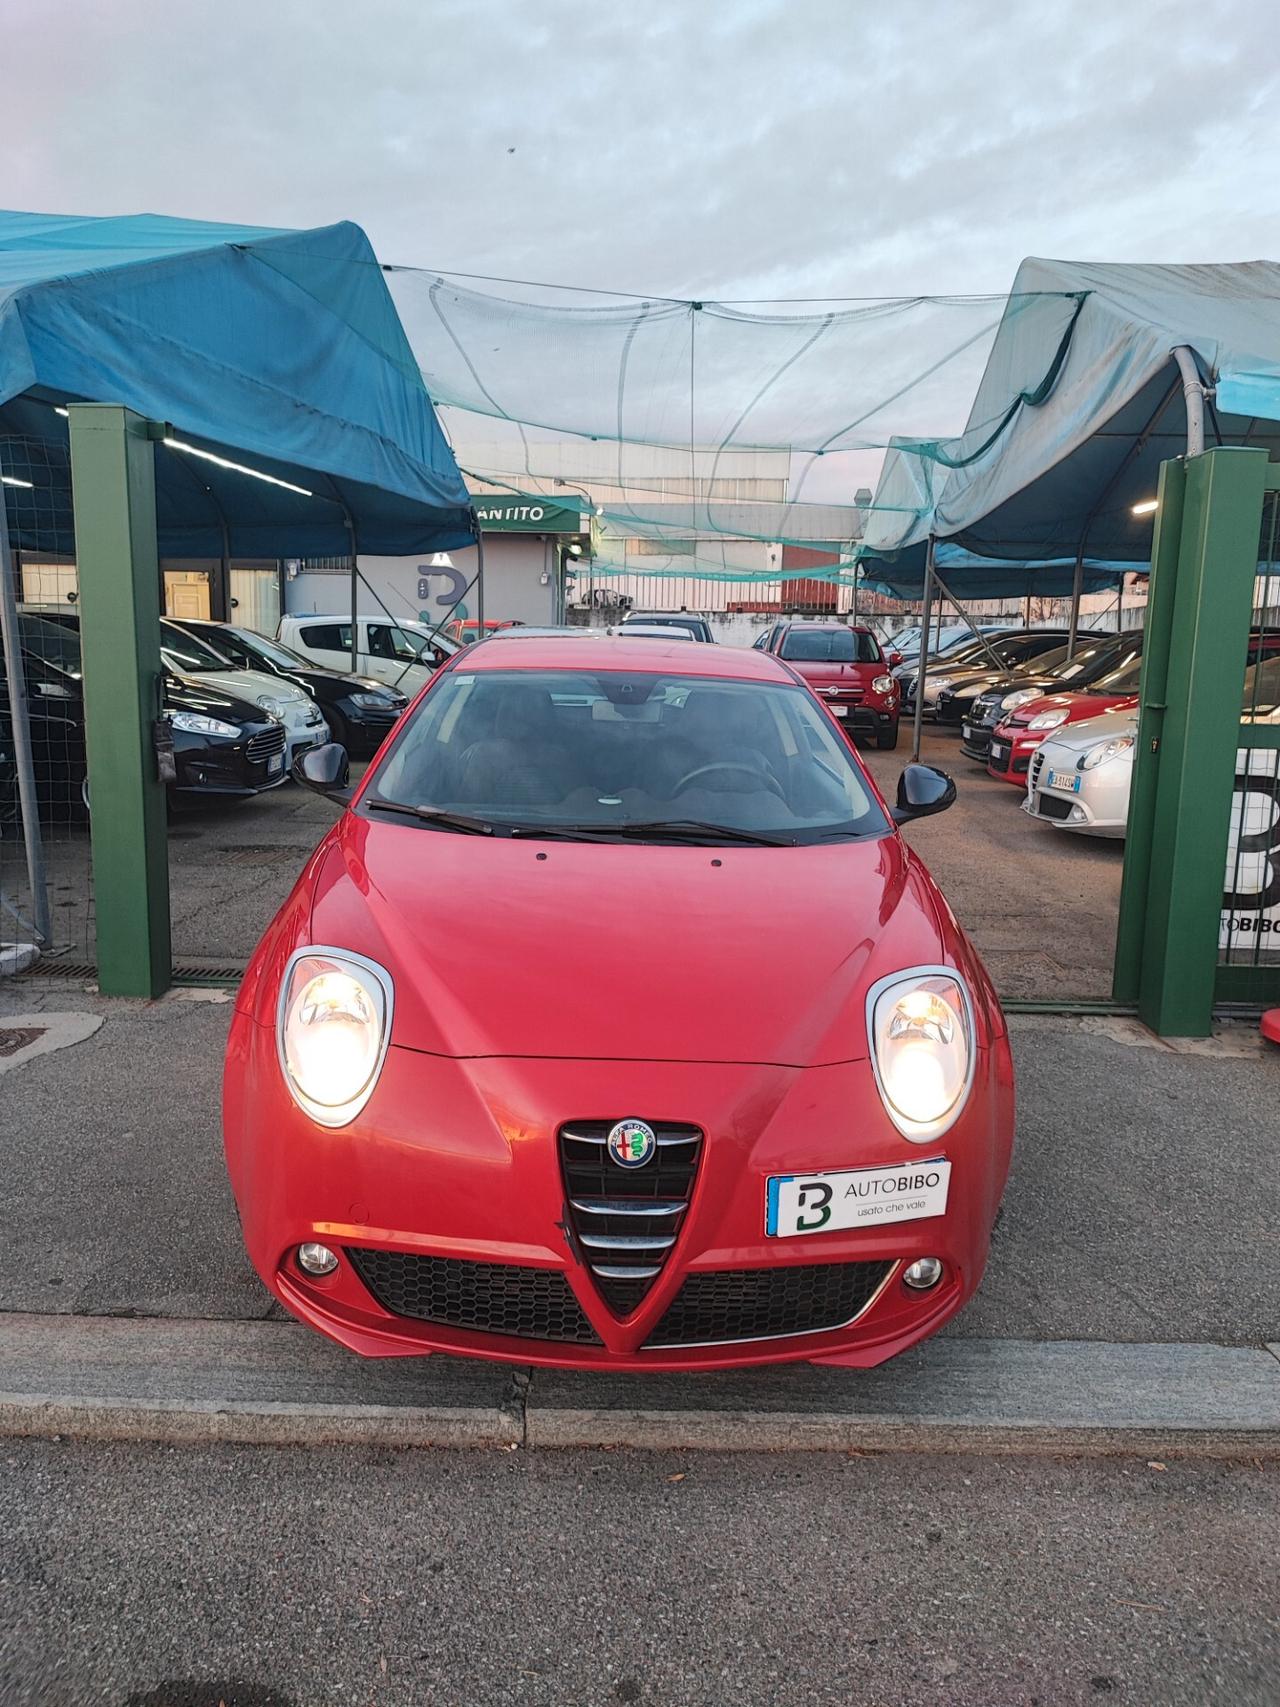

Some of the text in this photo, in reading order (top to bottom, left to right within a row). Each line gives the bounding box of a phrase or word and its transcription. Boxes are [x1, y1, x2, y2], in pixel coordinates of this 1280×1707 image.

[844, 1172, 940, 1199] AUTOBIBO
[857, 1200, 926, 1217] usato che vale
